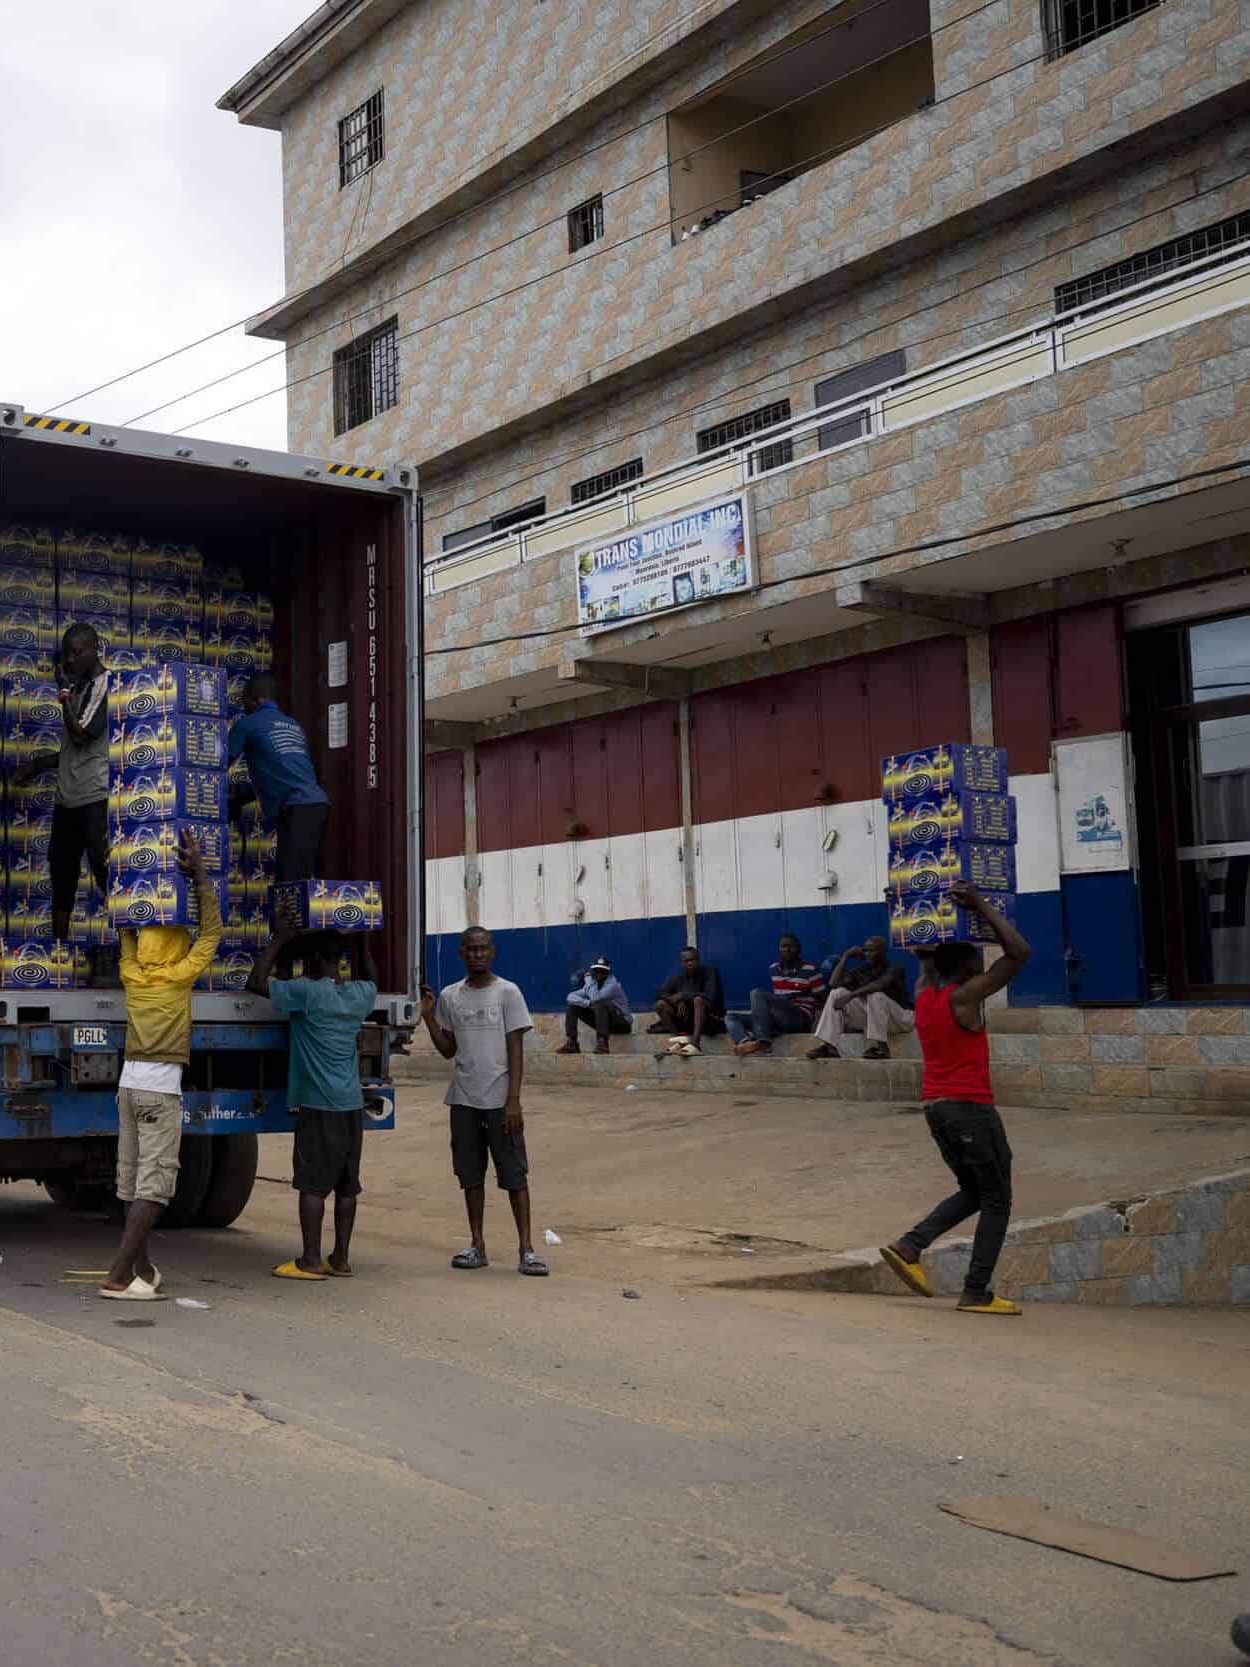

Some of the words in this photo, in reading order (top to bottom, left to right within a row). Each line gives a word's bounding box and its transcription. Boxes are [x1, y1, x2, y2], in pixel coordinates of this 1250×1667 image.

[596, 538, 638, 568] TRANS
[642, 515, 705, 551] MONDIAL
[366, 543, 377, 630] MRSU
[368, 635, 377, 697] 651
[368, 701, 377, 763] 438
